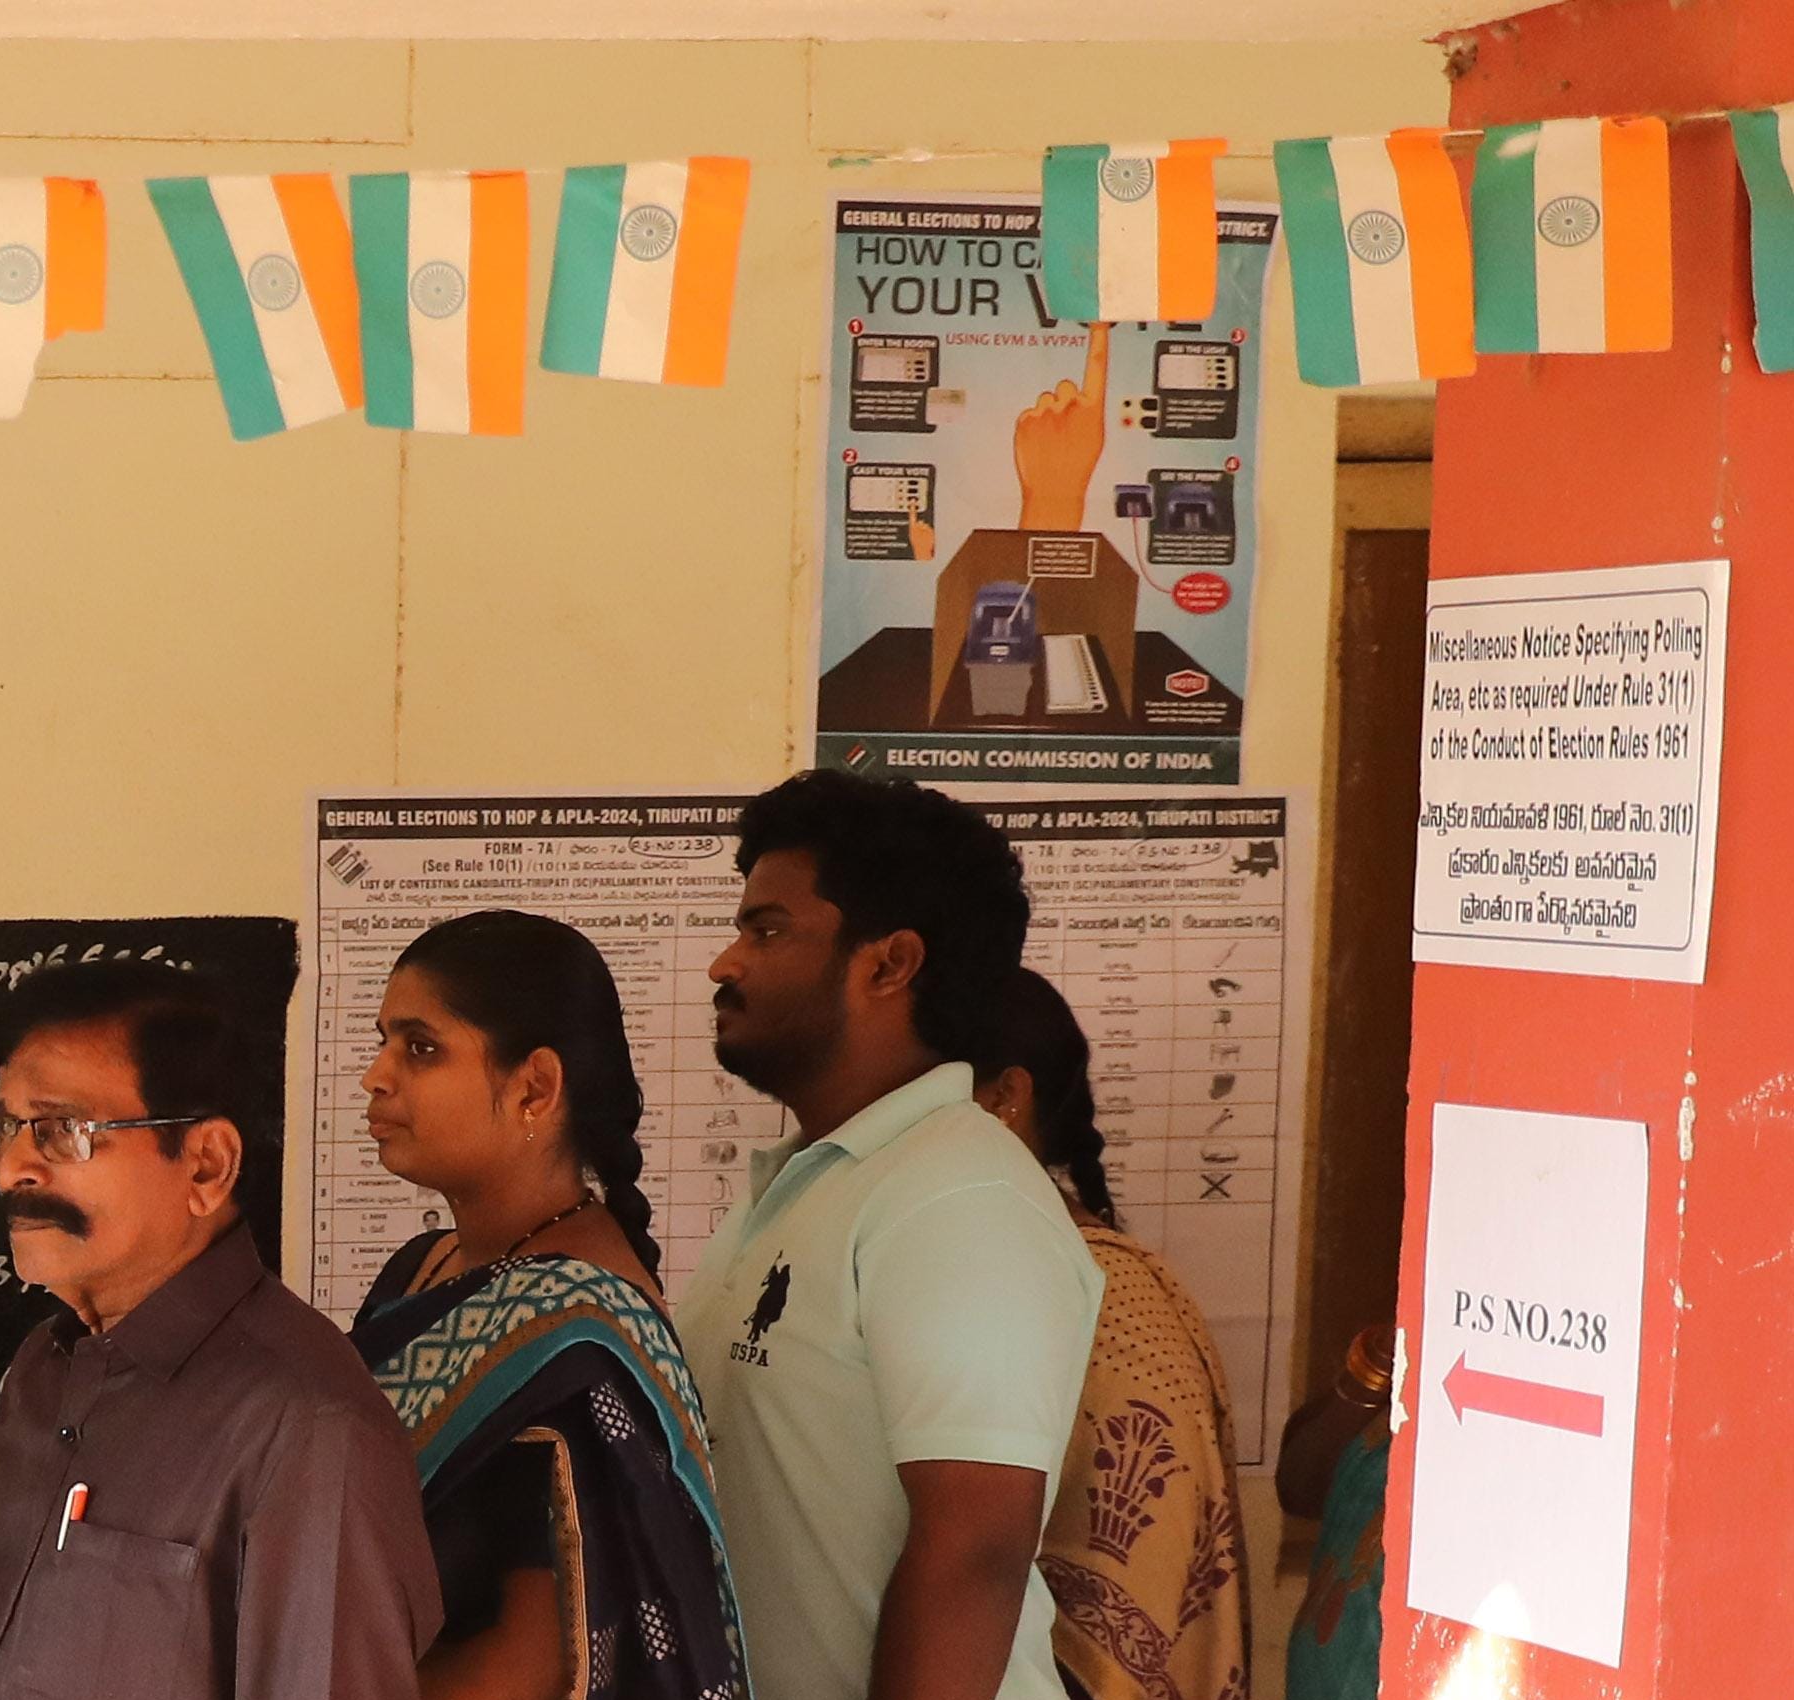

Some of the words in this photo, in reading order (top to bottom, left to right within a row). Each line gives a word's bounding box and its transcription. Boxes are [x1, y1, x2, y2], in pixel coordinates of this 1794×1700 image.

[843, 211, 904, 226] GENERAL
[907, 212, 981, 229] ELECTIONS
[984, 215, 1001, 228] TO
[1004, 215, 1033, 230] HOP
[856, 237, 946, 265] HOW
[957, 240, 1001, 267] TO
[857, 276, 999, 316] YOUR
[946, 334, 990, 346] USING
[994, 335, 1024, 346] EVM
[1029, 336, 1038, 346] &
[1429, 626, 1517, 663] Miscellaneous
[1521, 626, 1571, 660] Notice
[1575, 622, 1649, 665] Specifying
[1654, 618, 1701, 661] Polling
[1431, 680, 1465, 718] Area,
[1469, 679, 1490, 711] etc
[1493, 684, 1507, 710] as
[1510, 676, 1569, 717] required
[1574, 676, 1617, 709] Under
[1621, 672, 1653, 707] Rule
[1657, 669, 1695, 714] 31(1)
[1431, 729, 1444, 760] of
[1448, 728, 1469, 761] the
[1471, 726, 1525, 761] Conduct
[1530, 725, 1544, 760] of
[1548, 725, 1604, 760] Election
[1610, 725, 1648, 760] Rules
[1655, 723, 1689, 759] 1961
[886, 749, 978, 768] ELECTION
[985, 750, 1123, 769] COMMISSION
[1128, 751, 1150, 769] OF
[1156, 752, 1213, 770] INDIA
[326, 811, 394, 827] GENERAL
[398, 810, 477, 826] ELECTIONS
[481, 811, 500, 825] TO
[505, 811, 534, 825] HOP
[541, 810, 553, 825] &
[556, 808, 643, 827] APLA-2024,
[647, 808, 712, 824] TIRUPATI
[1007, 813, 1038, 828] HOP
[1215, 810, 1281, 826] DISTRICT
[1553, 804, 1587, 834] 1961,
[1659, 803, 1693, 835] 31(1)
[484, 842, 522, 854] FORM
[538, 842, 553, 854] 7A
[422, 859, 453, 873] (See
[455, 859, 483, 872] Rule
[489, 859, 522, 873] 10(1)
[360, 880, 380, 890] LIST
[384, 880, 395, 889] OF
[399, 879, 459, 890] CONTESTING
[1453, 1288, 1496, 1334] P.S
[1502, 1297, 1608, 1355] NO.238
[730, 1342, 769, 1367] USPA
